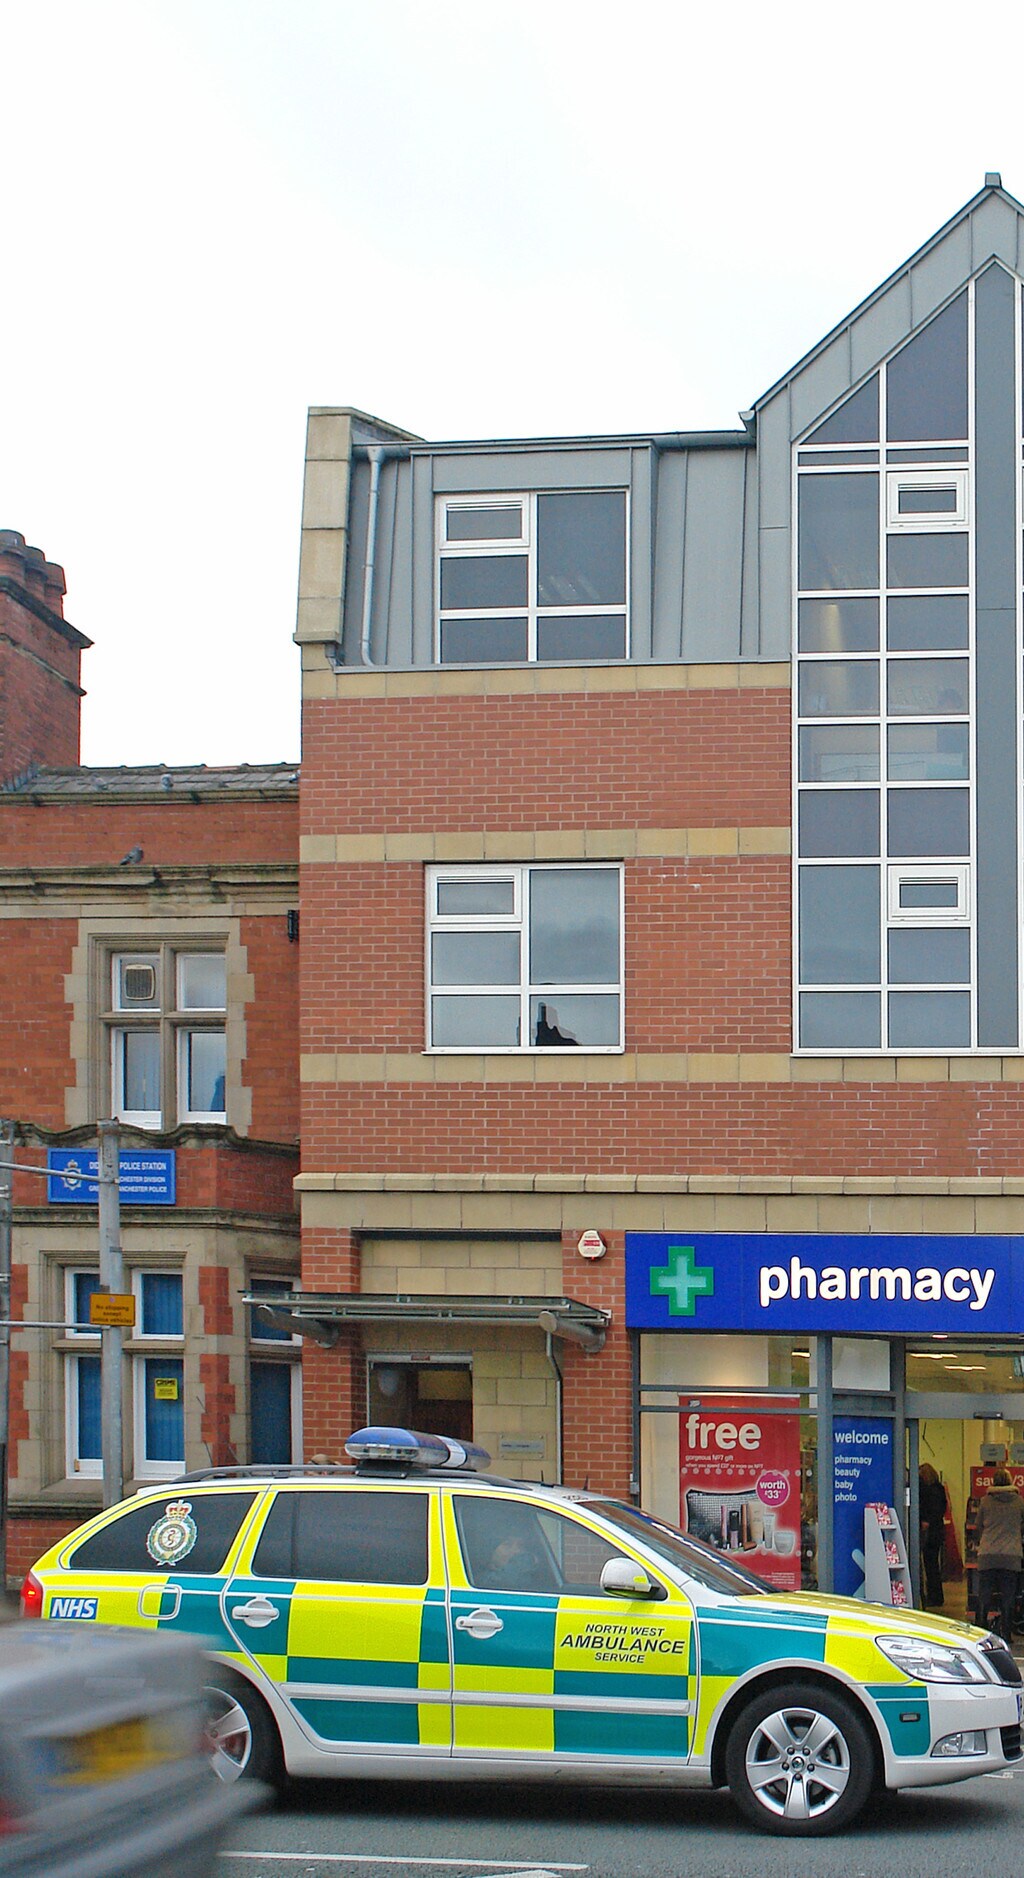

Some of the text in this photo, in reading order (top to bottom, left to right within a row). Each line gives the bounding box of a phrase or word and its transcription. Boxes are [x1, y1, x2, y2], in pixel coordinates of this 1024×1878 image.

[119, 1162, 167, 1171] POLICE STATION
[118, 1185, 148, 1193] ANCHESTER
[758, 1256, 996, 1311] pharmacy
[686, 1413, 762, 1450] free
[834, 1430, 889, 1445] welcome
[834, 1455, 872, 1466] pharmacy
[834, 1467, 860, 1478] beauty
[760, 1480, 786, 1490] worth
[834, 1480, 854, 1490] baby
[975, 1476, 994, 1487] sav
[834, 1492, 857, 1503] photo
[51, 1599, 96, 1618] NHS
[585, 1624, 665, 1637] NORTH WEST
[560, 1634, 685, 1654] AMBULANCE
[595, 1652, 645, 1664] SERVICE
